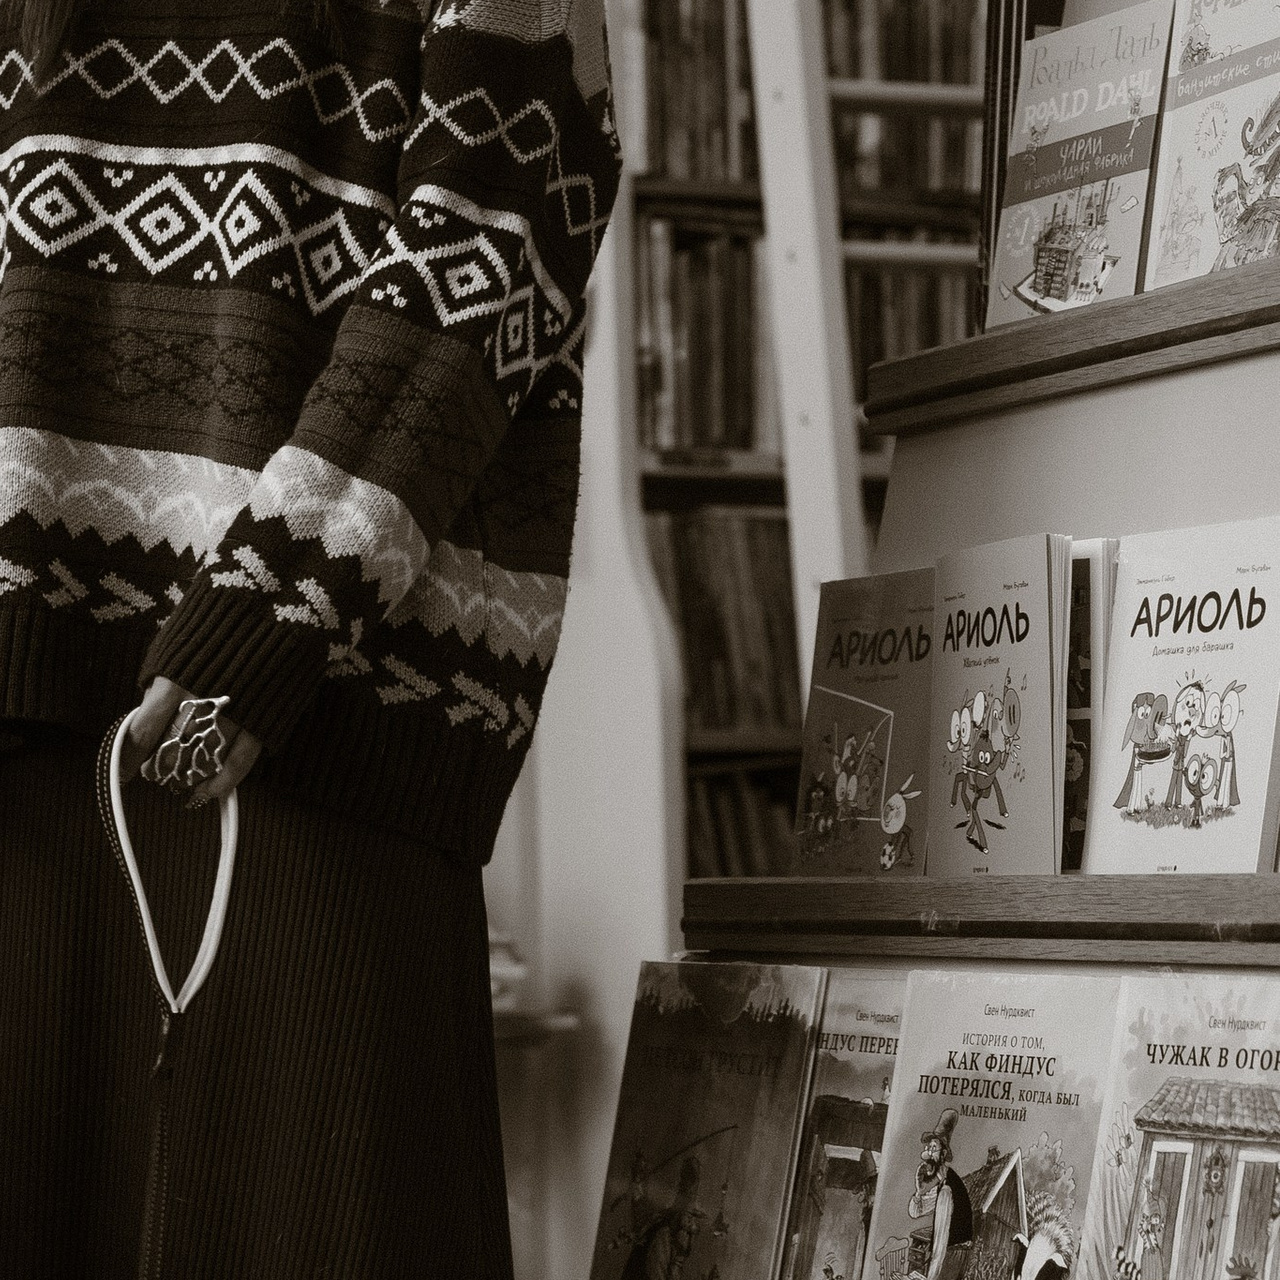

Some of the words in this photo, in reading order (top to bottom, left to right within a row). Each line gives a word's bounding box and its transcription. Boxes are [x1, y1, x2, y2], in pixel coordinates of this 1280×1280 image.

[1177, 64, 1250, 97] бандитские
[1022, 88, 1089, 133] ROALD
[1094, 69, 1156, 113] DAHL
[1059, 136, 1102, 167] ЧАРЛИ
[1094, 148, 1135, 171] ФАБРИКА
[1130, 586, 1266, 638] АРИОЛЬ
[942, 602, 1030, 653] АРИОЛЬ
[826, 624, 931, 670] АРИОЛЬ
[1152, 645, 1184, 657] Домашка
[1186, 644, 1200, 656] для
[1201, 641, 1234, 653] барашка
[984, 1003, 999, 1016] Свен
[1000, 1004, 1035, 1018] Нурдквист
[1208, 1015, 1227, 1029] Свен
[1228, 1016, 1266, 1032] Нурдквист
[962, 1033, 1008, 1048] ИСТОРИЯ
[1010, 1036, 1018, 1048] О
[1020, 1036, 1046, 1051] ТОМ,
[1146, 1043, 1212, 1067] ЧУЖАК
[1217, 1047, 1229, 1068] В
[946, 1050, 979, 1071] КАК
[984, 1053, 1057, 1078] ФИНДУС
[918, 1074, 1015, 1104] ПОТЕРЯЛСЯ,
[1018, 1088, 1052, 1104] КОГДА
[1056, 1091, 1080, 1107] БЫЛ
[960, 1103, 1027, 1122] МАЛЕНЬКИЙ
